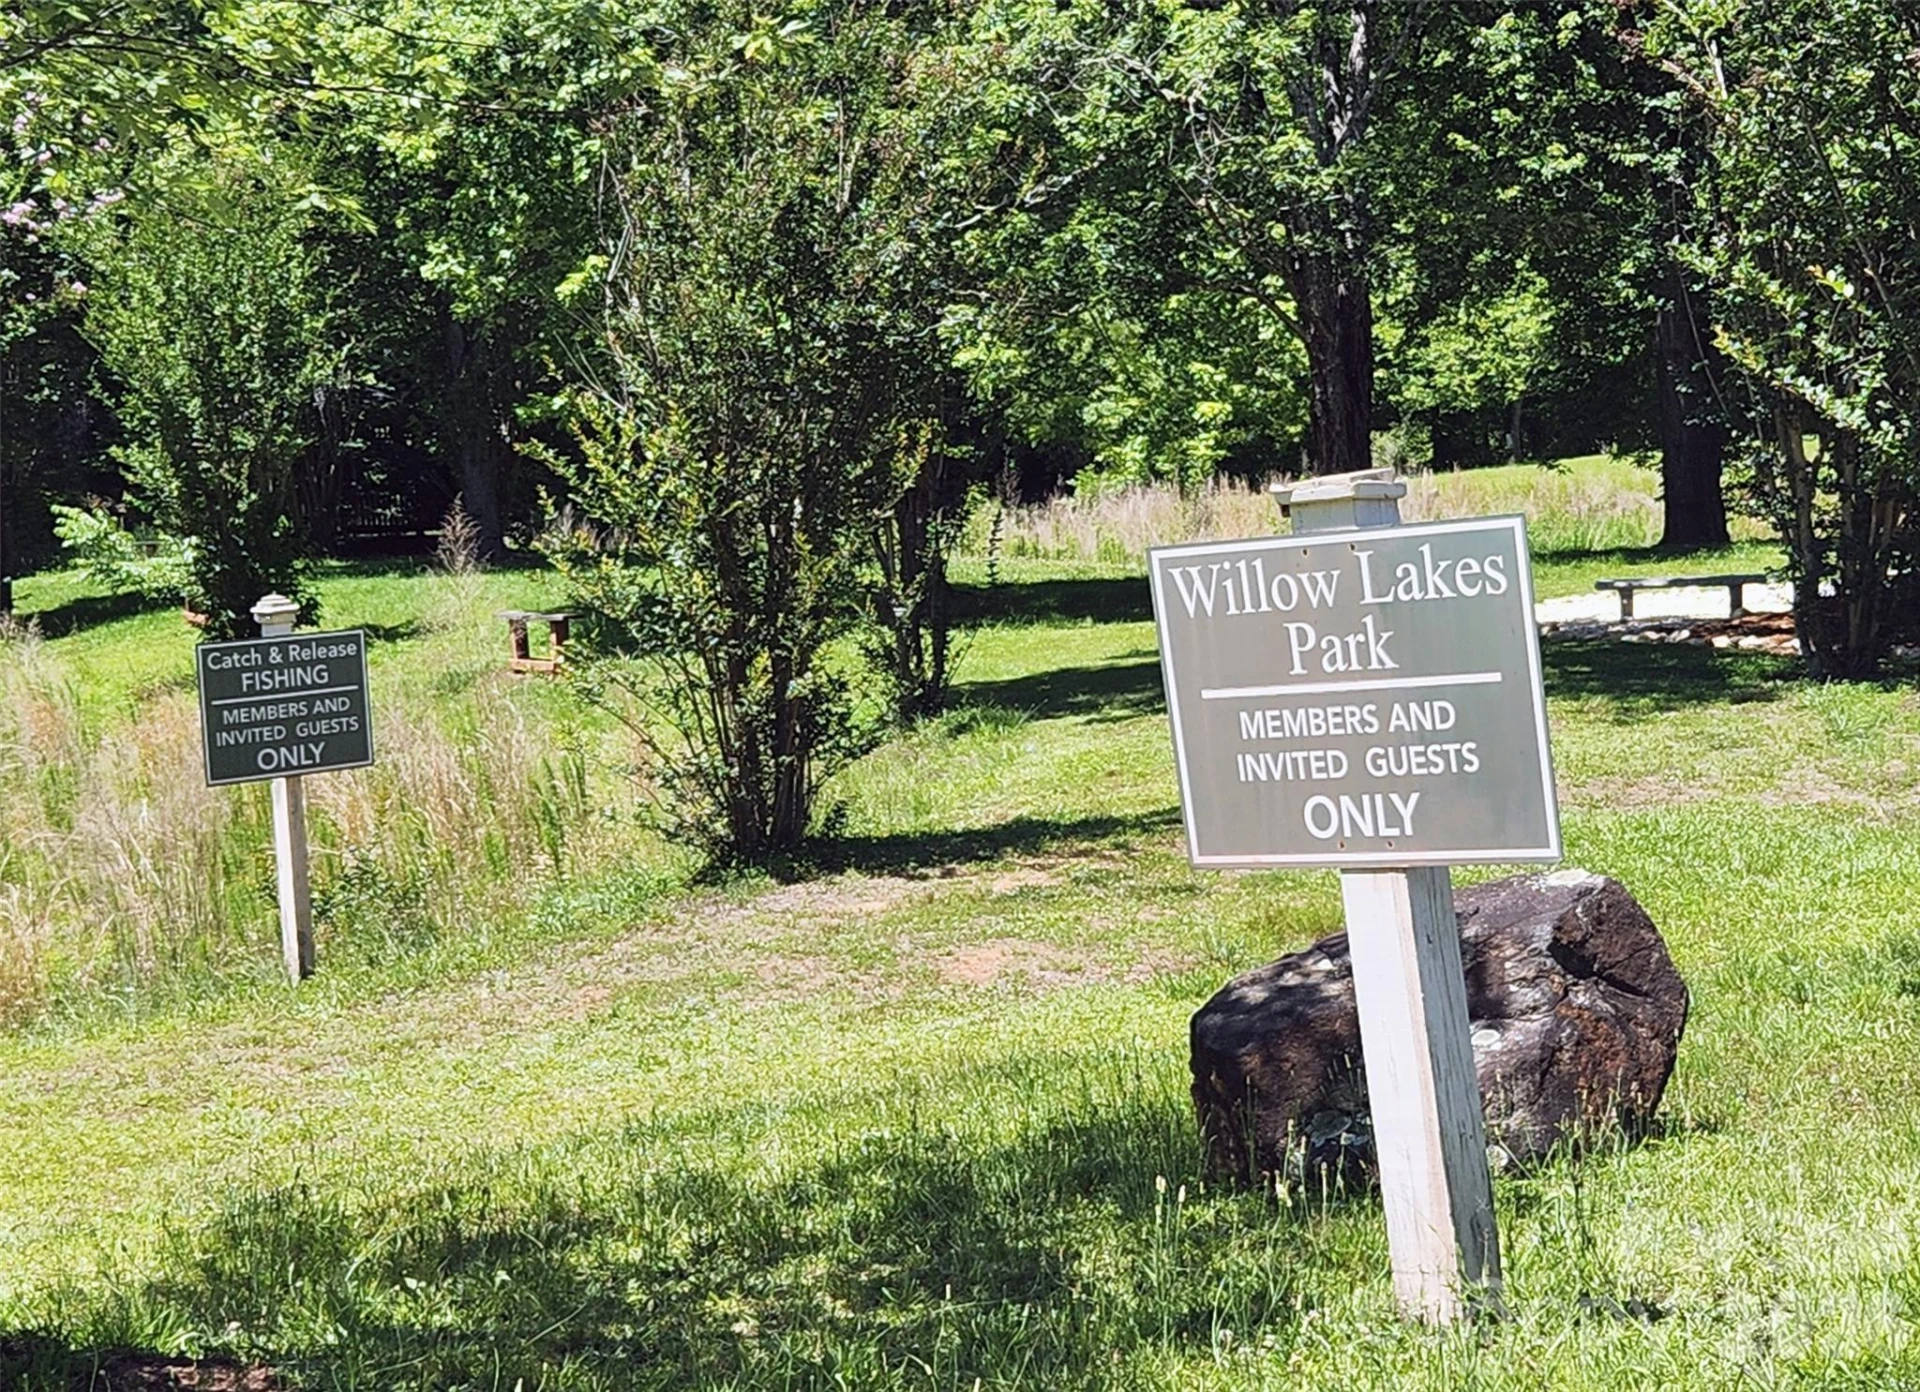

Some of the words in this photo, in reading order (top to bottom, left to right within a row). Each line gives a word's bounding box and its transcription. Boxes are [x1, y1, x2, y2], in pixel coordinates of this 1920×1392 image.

[1168, 557, 1341, 619] Willow
[1354, 543, 1508, 605] Lakes
[207, 648, 262, 670] Catch
[268, 646, 284, 664] &
[288, 641, 358, 662] Release
[1283, 614, 1399, 676] Park
[241, 664, 329, 692] FISHING
[223, 701, 308, 725] MEMBERS
[312, 697, 350, 715] AND
[1239, 704, 1379, 740] MEMBERS
[1388, 700, 1456, 733] AND
[216, 725, 287, 747] INVITED
[296, 716, 359, 737] GUESTS
[257, 741, 326, 770] ONLY
[1237, 749, 1348, 782] INVITED
[1365, 741, 1480, 778] GUESTS
[1303, 791, 1420, 840] ONLY
